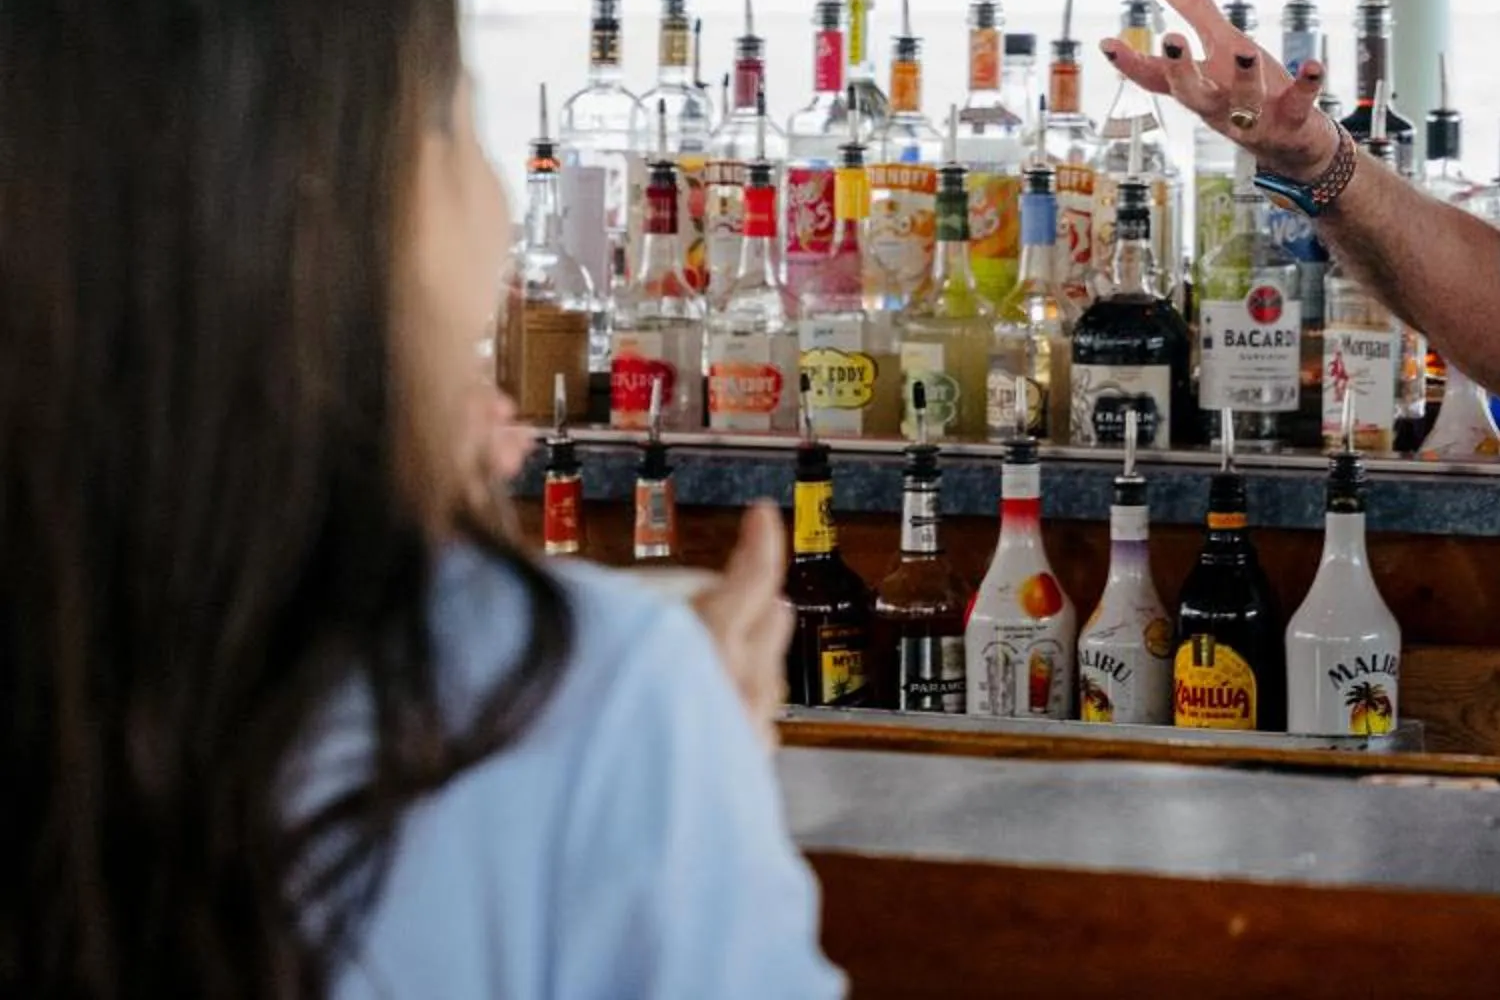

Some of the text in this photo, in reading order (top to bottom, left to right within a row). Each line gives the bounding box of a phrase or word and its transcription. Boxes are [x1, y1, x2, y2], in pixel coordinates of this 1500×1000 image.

[1224, 329, 1299, 347] BACARD
[828, 365, 865, 383] EDDY
[1328, 653, 1398, 690] MALIB
